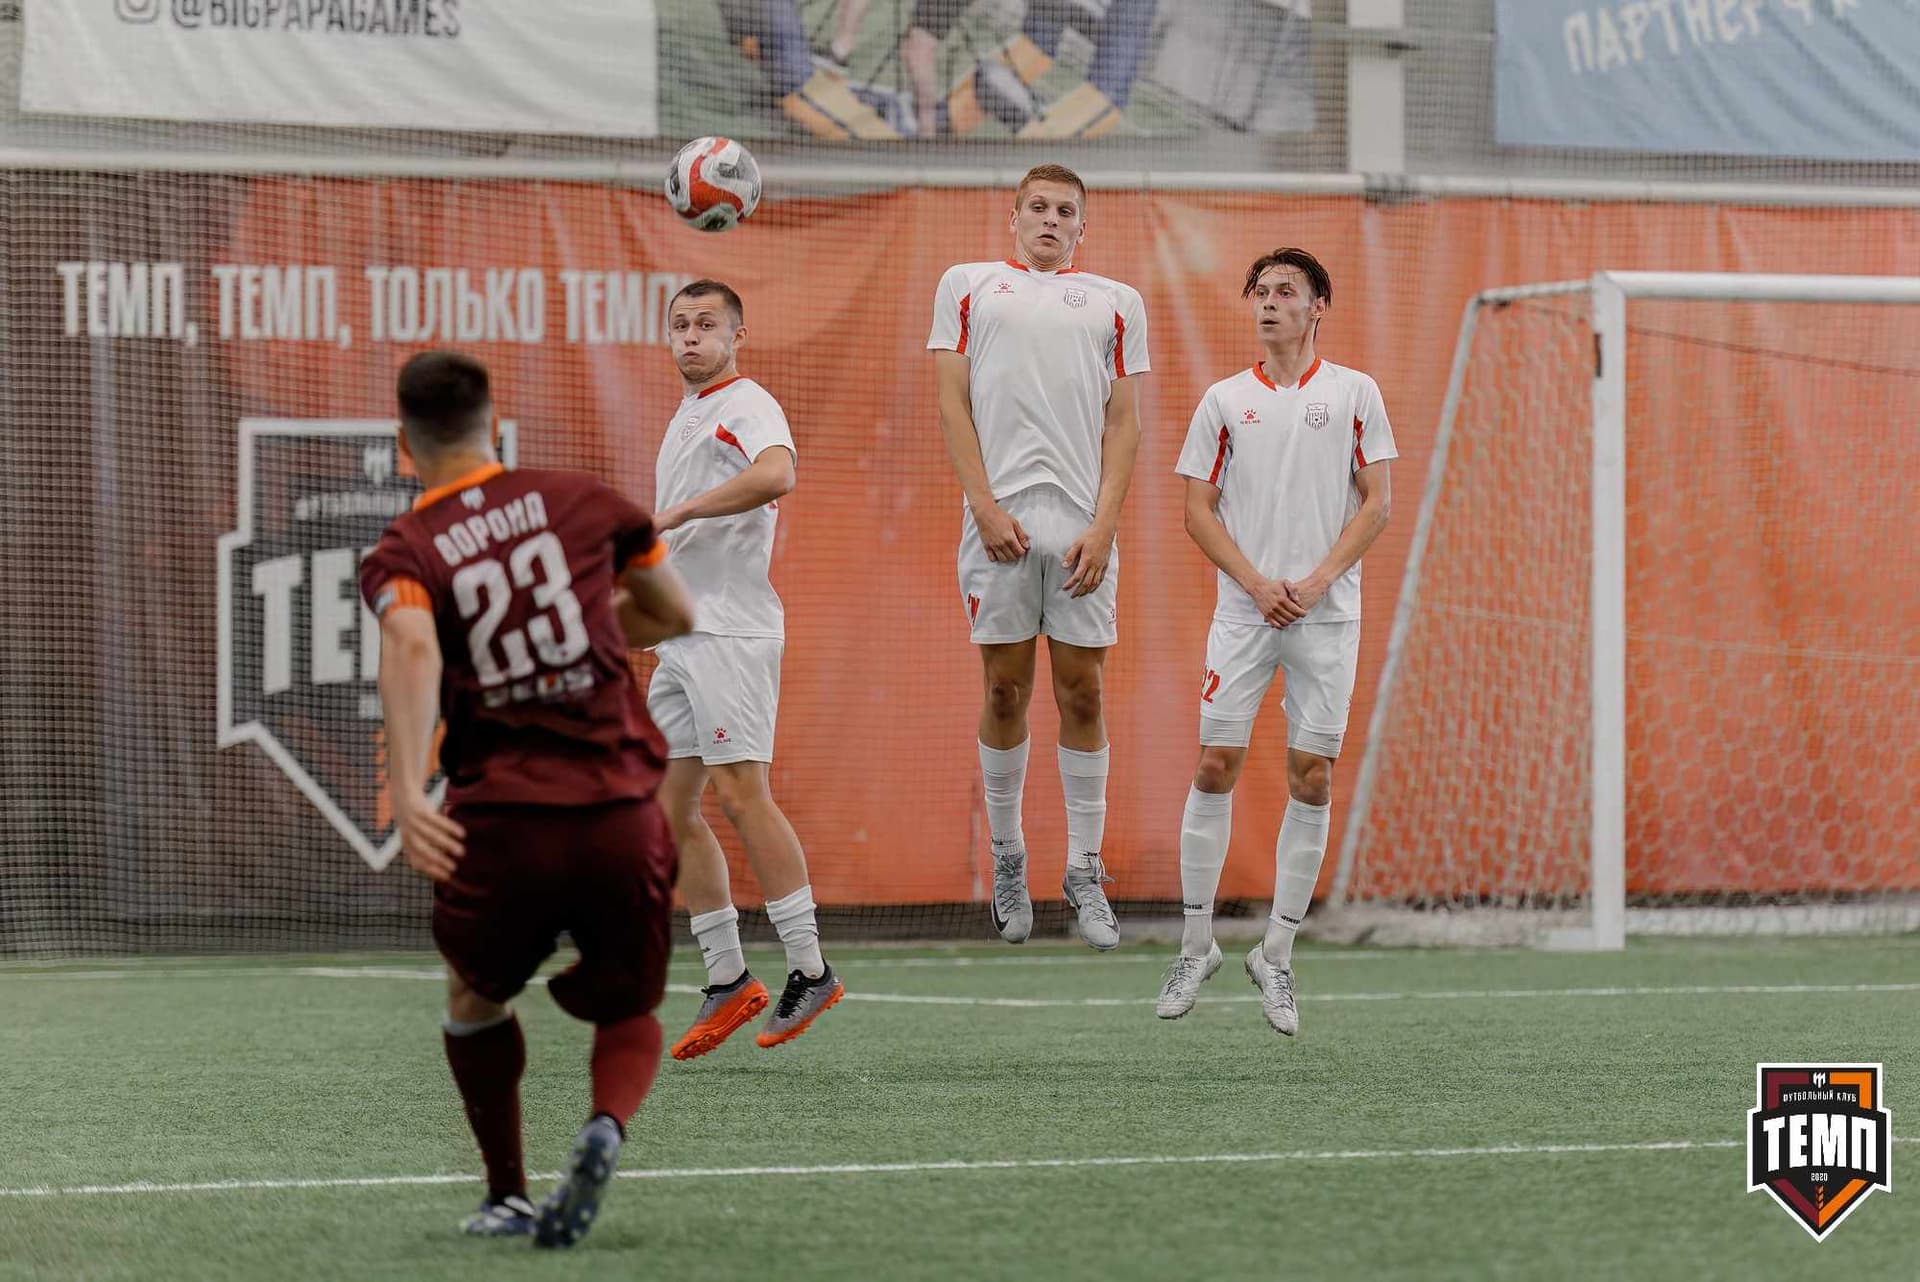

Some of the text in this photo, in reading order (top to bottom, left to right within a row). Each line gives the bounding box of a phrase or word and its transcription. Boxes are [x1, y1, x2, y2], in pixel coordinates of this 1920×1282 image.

[57, 261, 692, 350] ТЕМП, ТЕМП, ТОЛЬКО ТЕМП
[433, 490, 548, 567] ВОРОНА
[252, 547, 381, 695] ТЕ
[452, 531, 590, 687] 23
